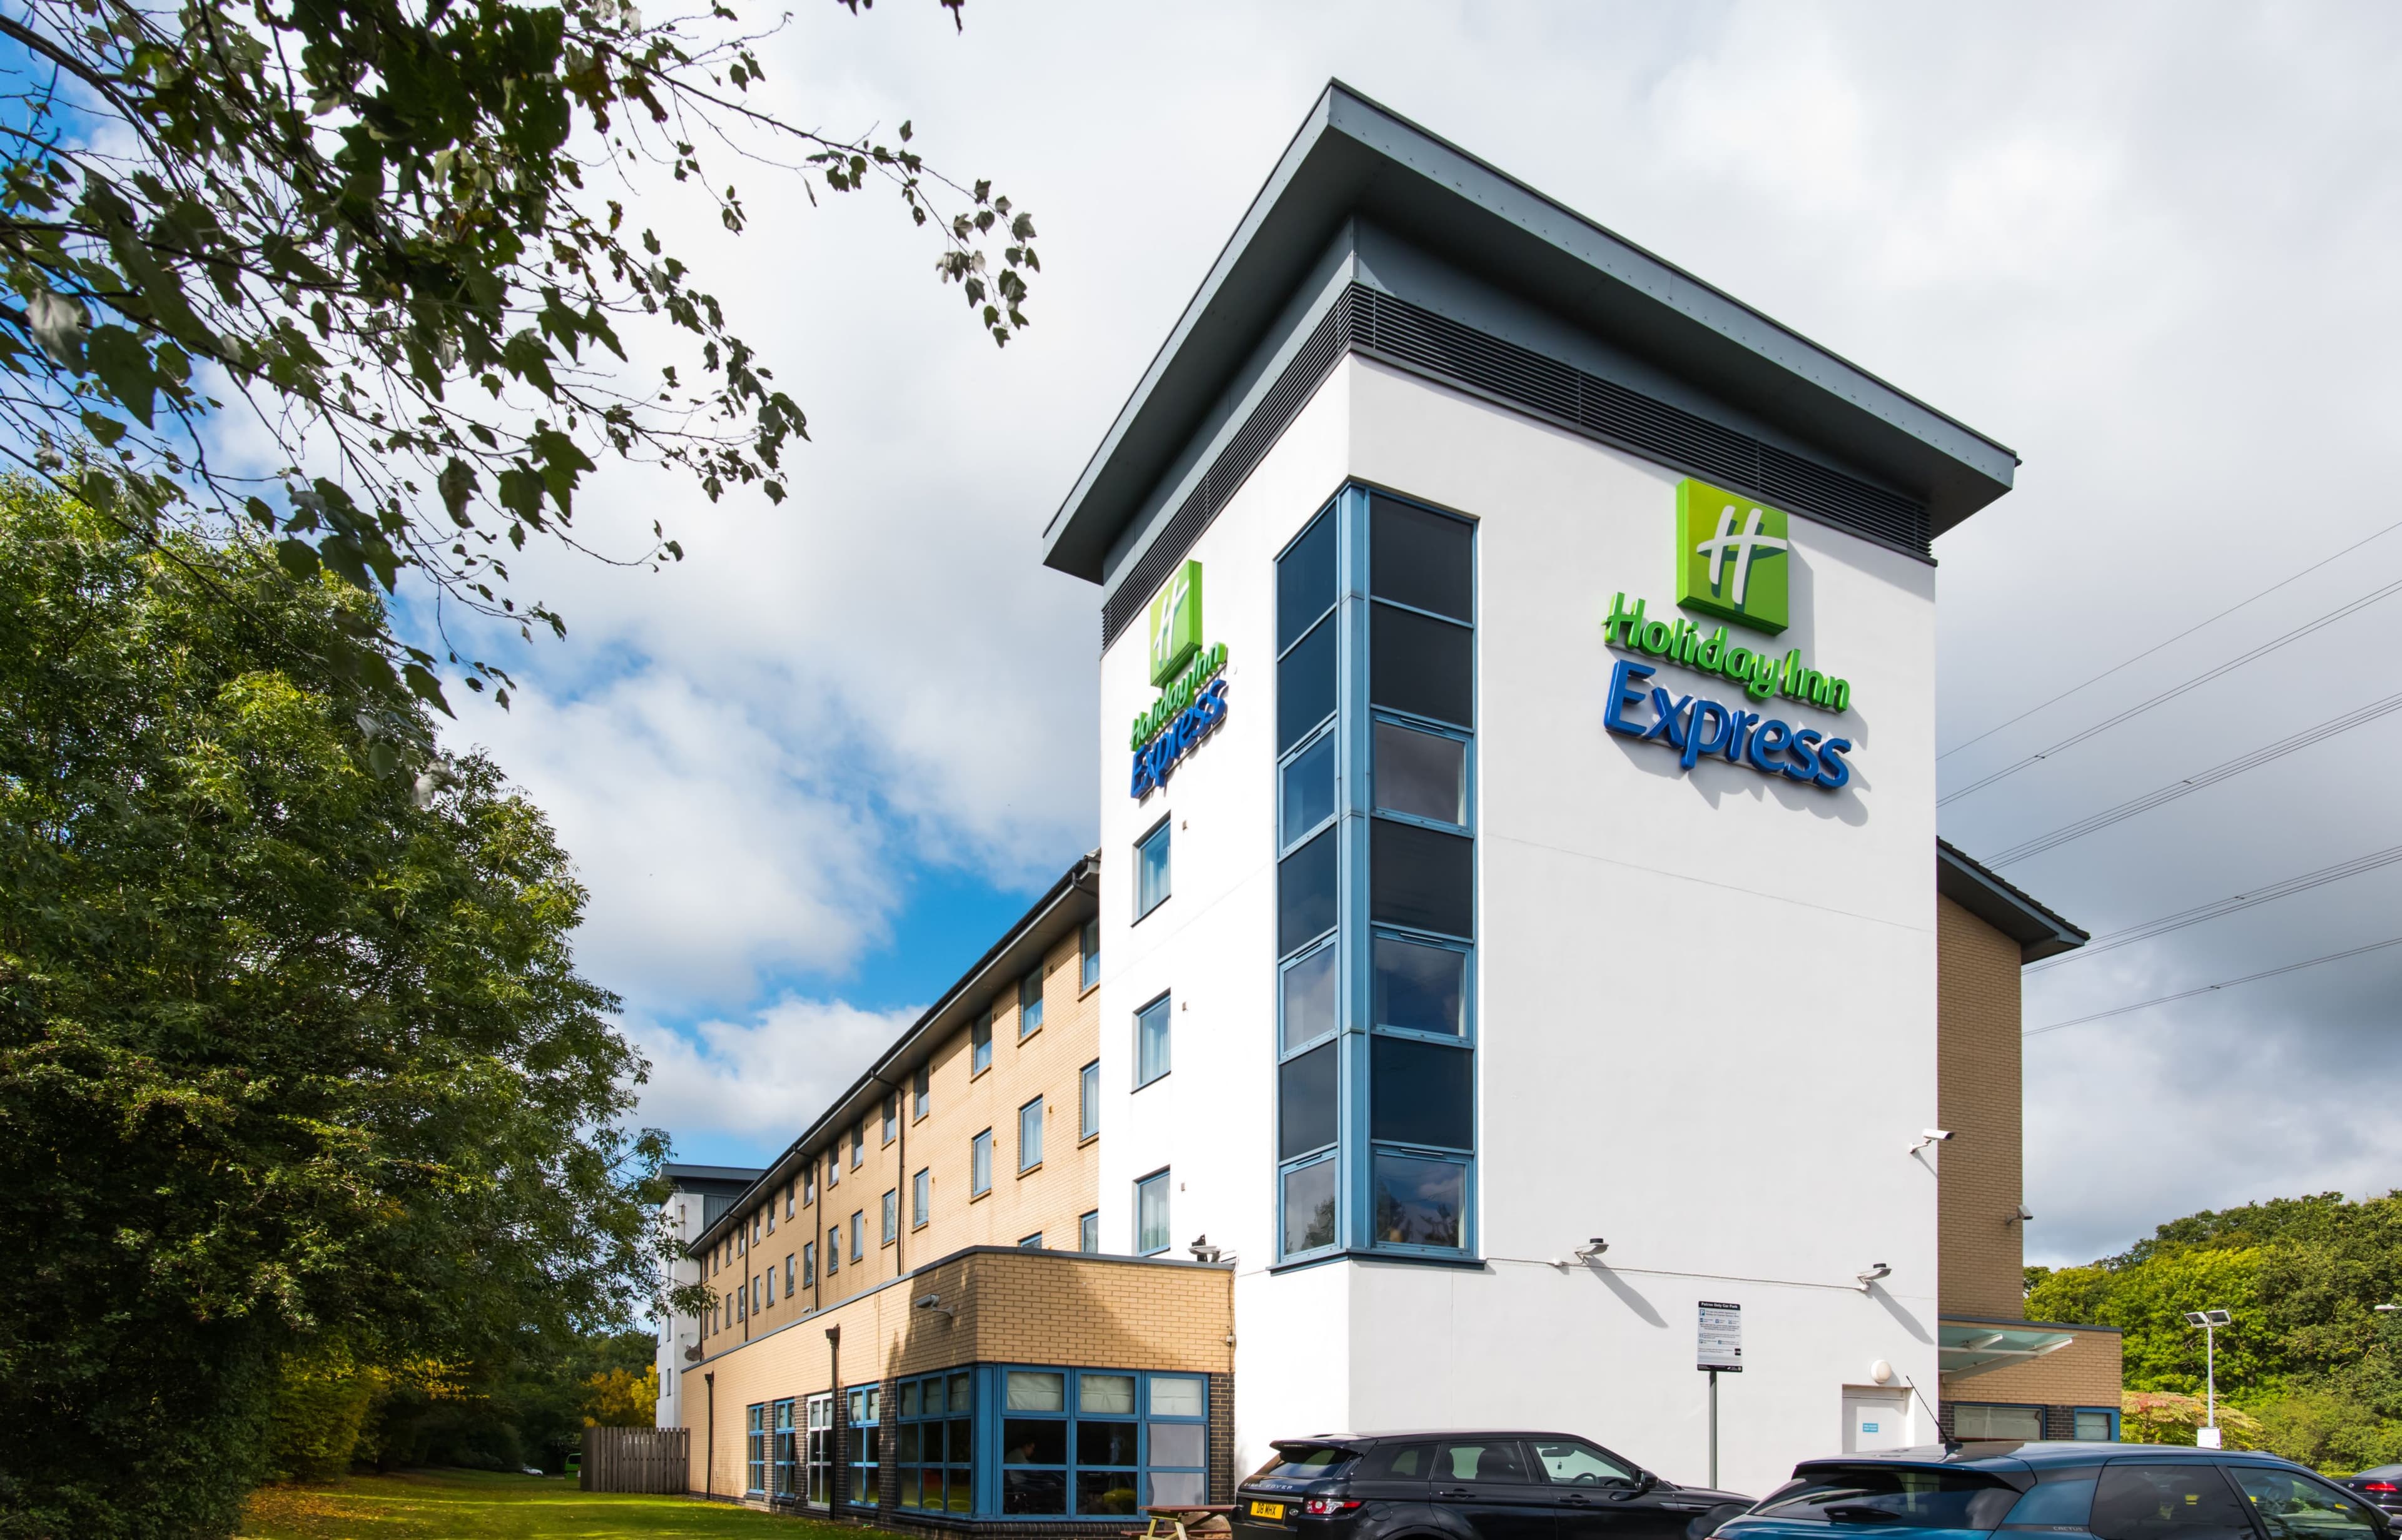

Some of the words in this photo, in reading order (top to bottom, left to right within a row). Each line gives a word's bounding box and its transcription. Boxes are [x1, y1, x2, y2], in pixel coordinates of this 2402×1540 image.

[1130, 671, 1194, 752] Holiday
[1192, 642, 1227, 688] Inn
[1601, 592, 1781, 701] Holiday
[1784, 648, 1851, 712] Inn
[1130, 679, 1227, 799] Express
[1603, 659, 1852, 789] Express
